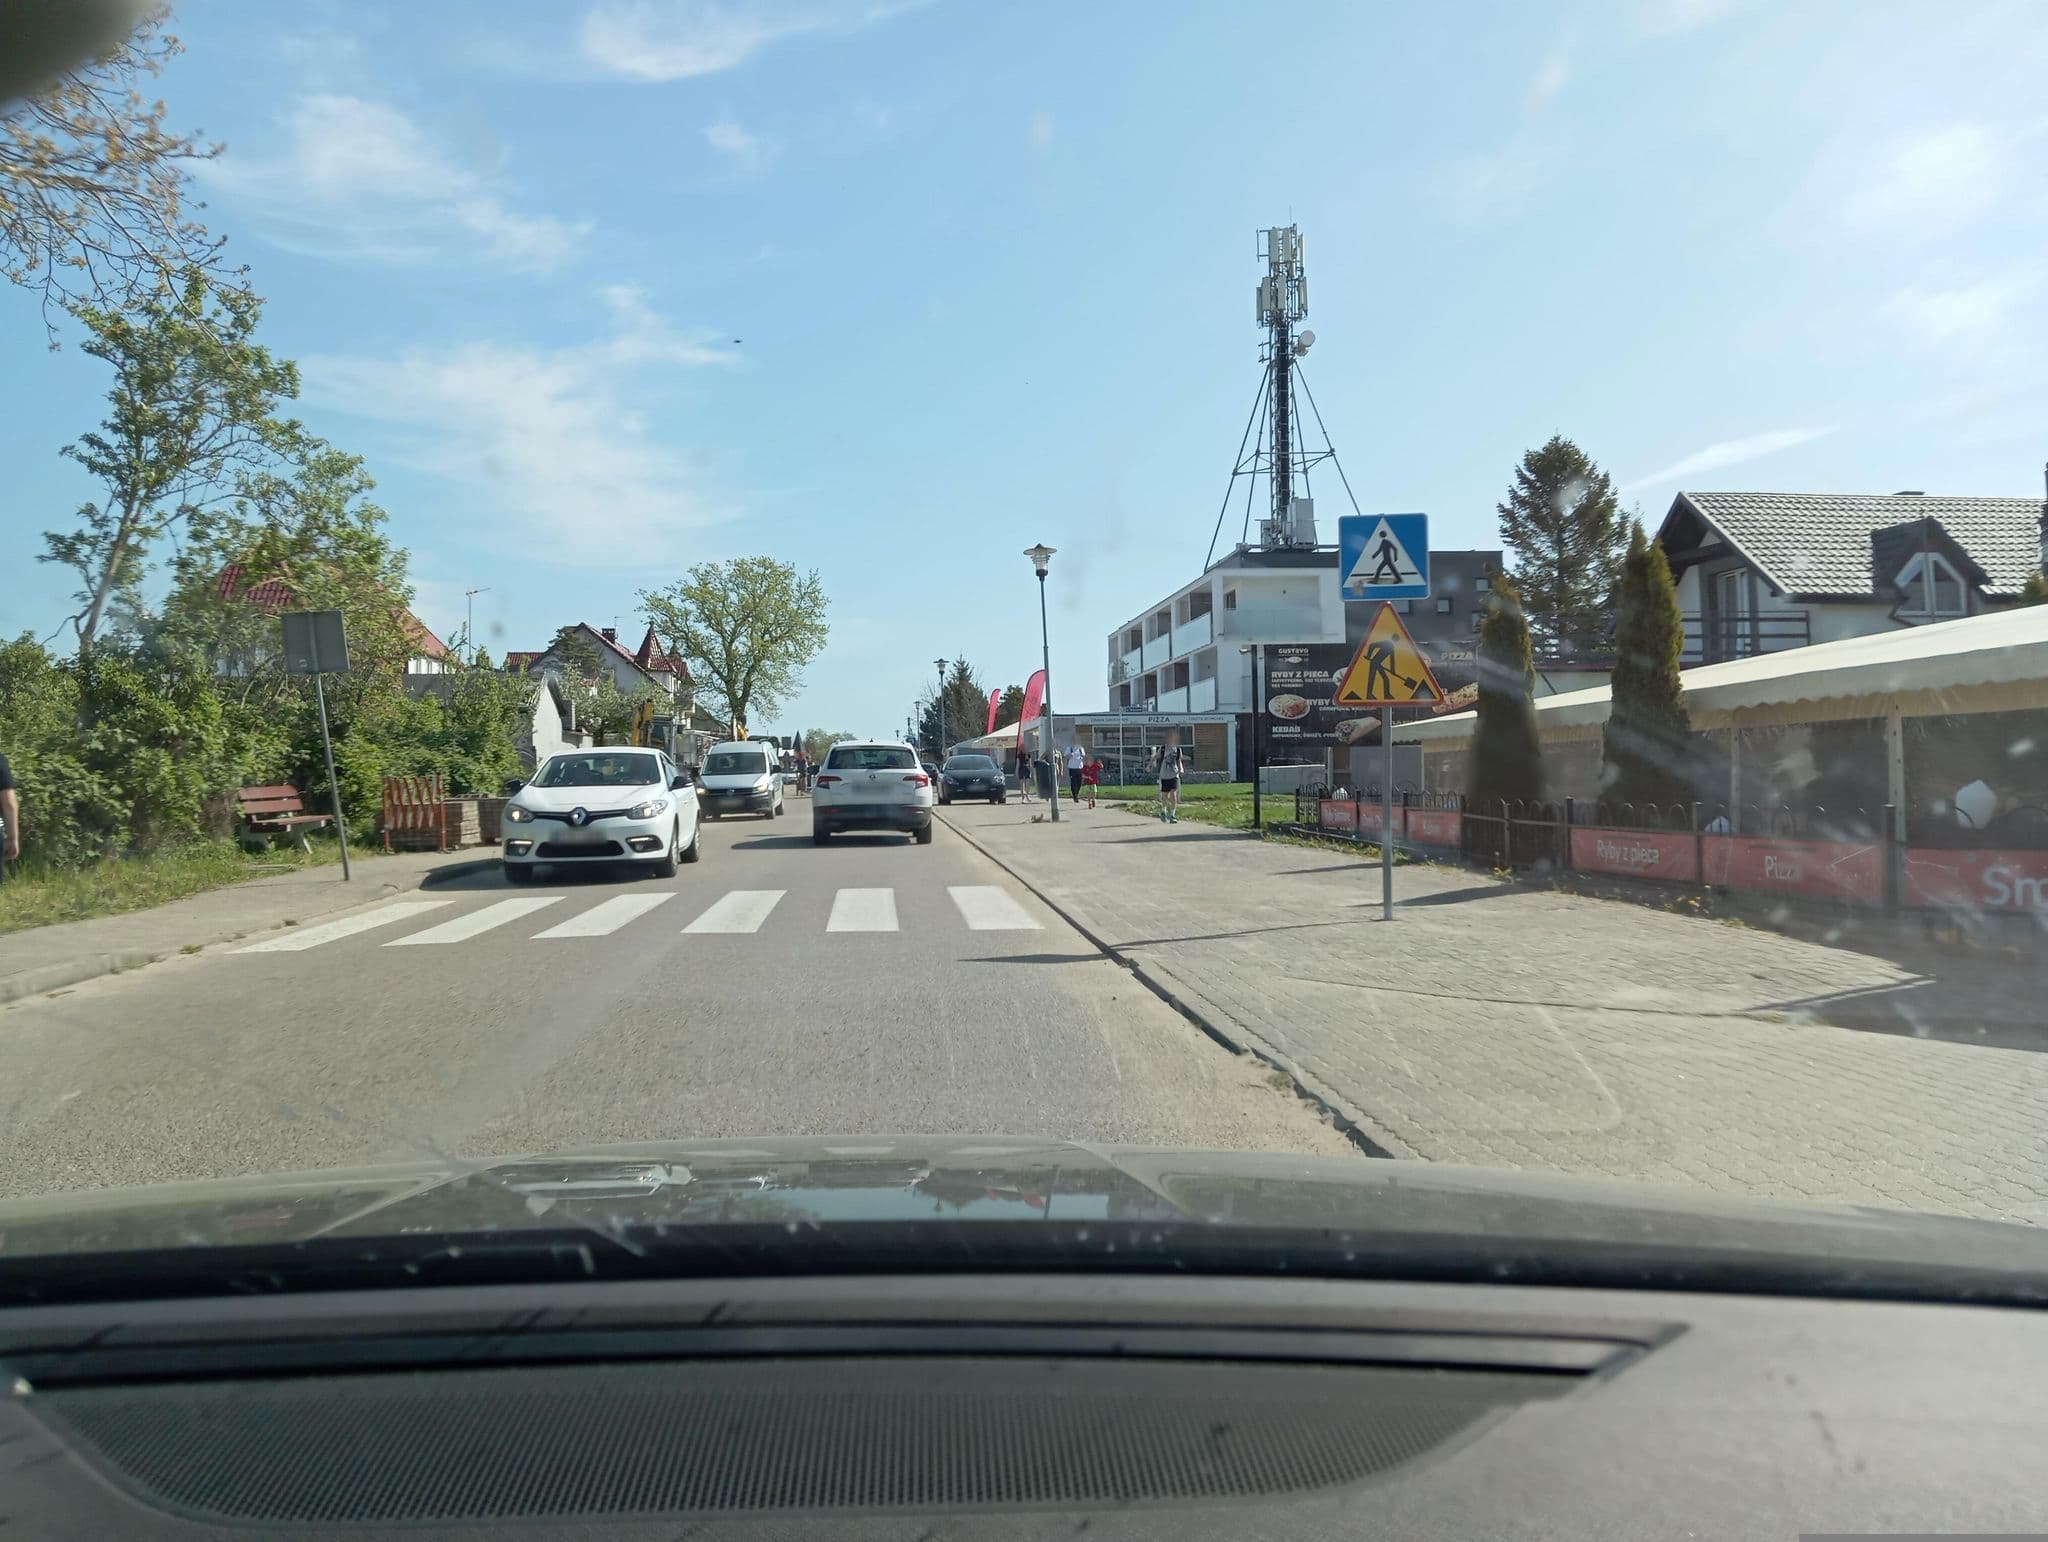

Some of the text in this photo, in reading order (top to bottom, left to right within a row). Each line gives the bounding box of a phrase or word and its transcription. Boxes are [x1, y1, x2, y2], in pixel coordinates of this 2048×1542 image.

[1596, 839, 1660, 865] Ryby z pieca
